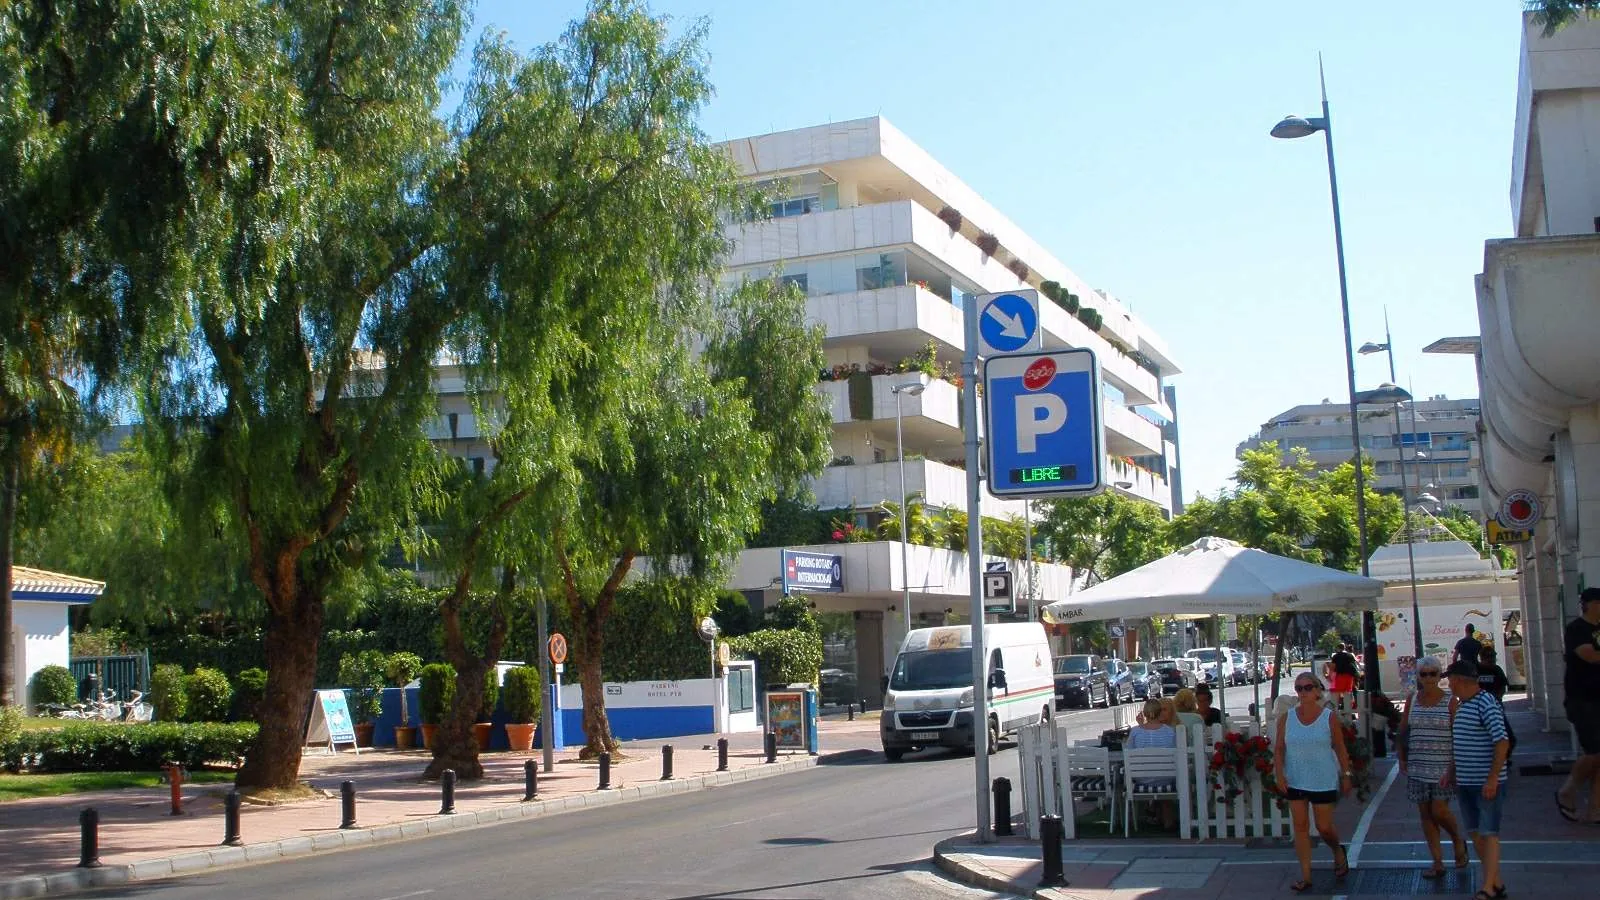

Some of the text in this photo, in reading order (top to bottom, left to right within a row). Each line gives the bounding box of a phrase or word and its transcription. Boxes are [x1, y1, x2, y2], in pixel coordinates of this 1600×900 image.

[1015, 393, 1068, 454] P
[1022, 466, 1061, 482] LIBRE
[1496, 531, 1522, 541] ATM
[987, 576, 1006, 597] P
